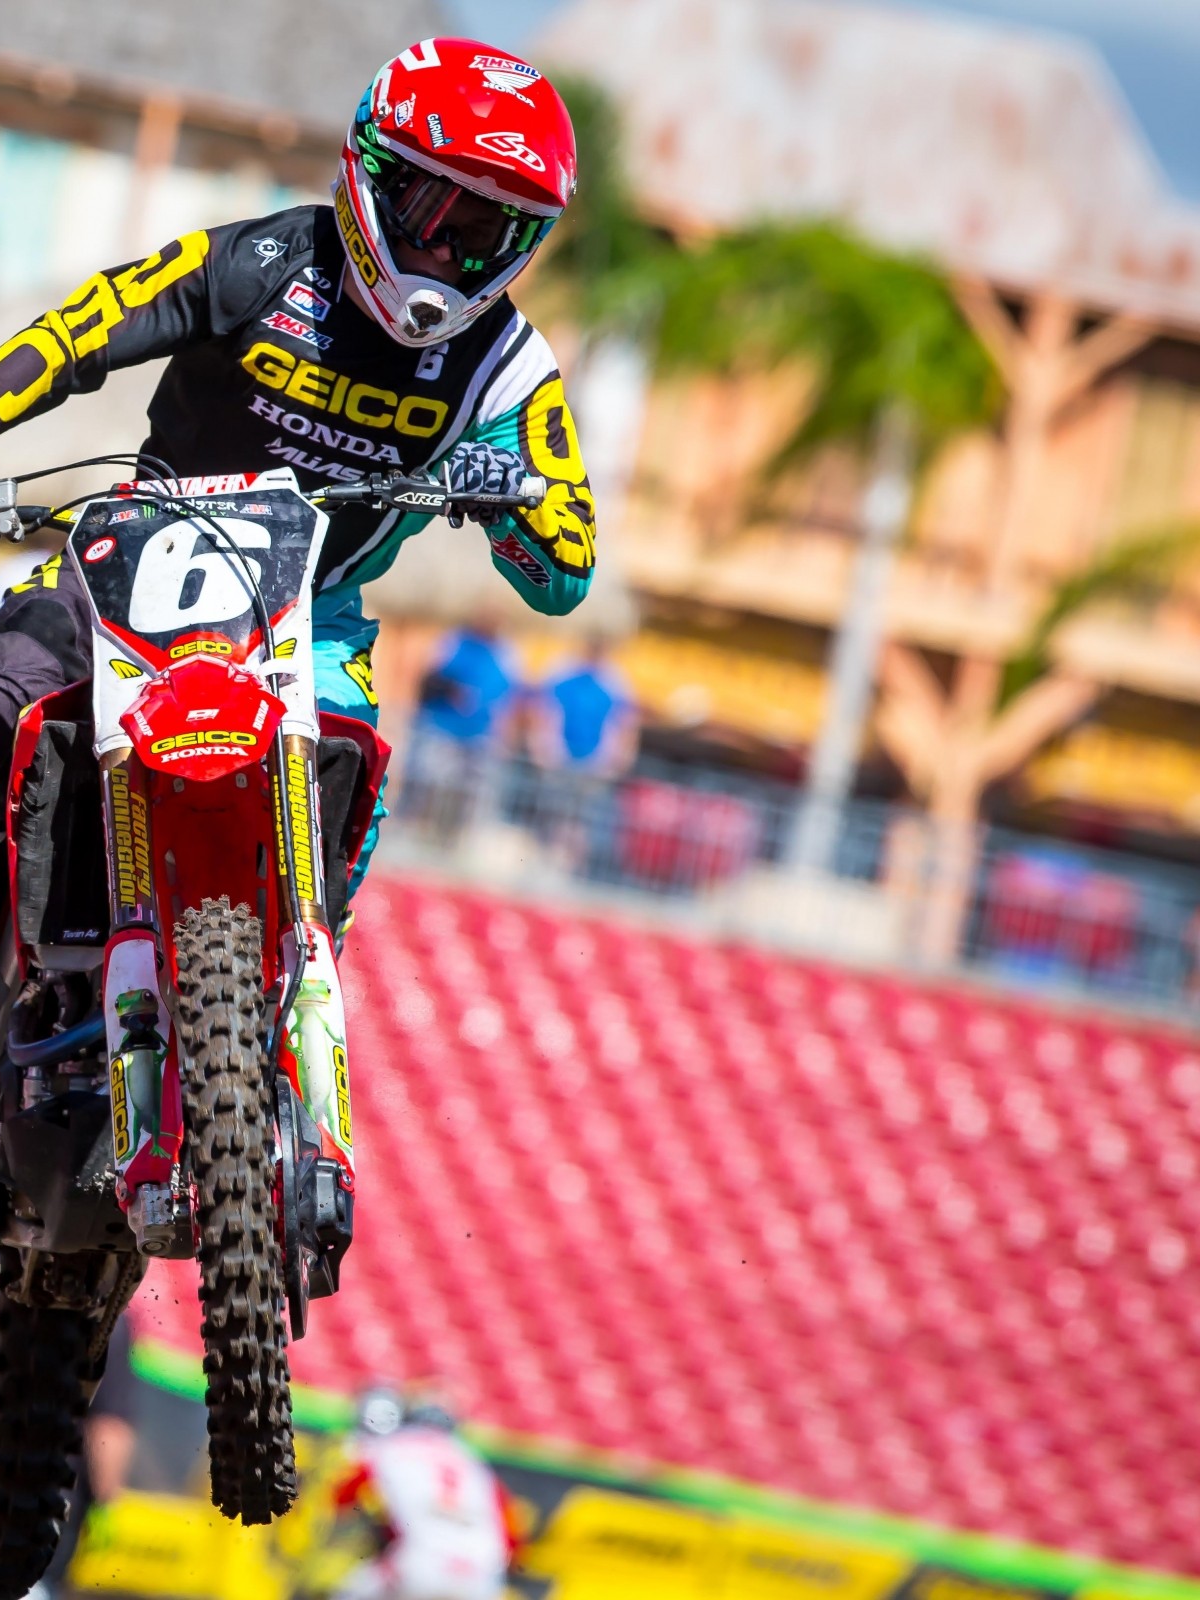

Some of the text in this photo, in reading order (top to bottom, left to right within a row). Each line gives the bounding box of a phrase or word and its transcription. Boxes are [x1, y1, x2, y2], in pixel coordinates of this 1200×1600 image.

[469, 55, 542, 80] AMSOIL
[482, 80, 536, 109] HONDA
[427, 114, 445, 149] GARMIN
[335, 180, 381, 289] GEICO
[261, 310, 334, 351] AMSOIL
[414, 341, 449, 381] 6
[242, 342, 449, 438] GEICO
[248, 394, 403, 465] HONDA
[394, 492, 446, 507] ARC
[128, 516, 272, 633] 6
[170, 640, 232, 659] GEICO
[252, 699, 269, 731] DUNLOP
[150, 730, 257, 754] GEICO
[160, 746, 249, 764] HONDA
[111, 1057, 130, 1160] GEICO
[333, 1045, 353, 1147] GEICO
